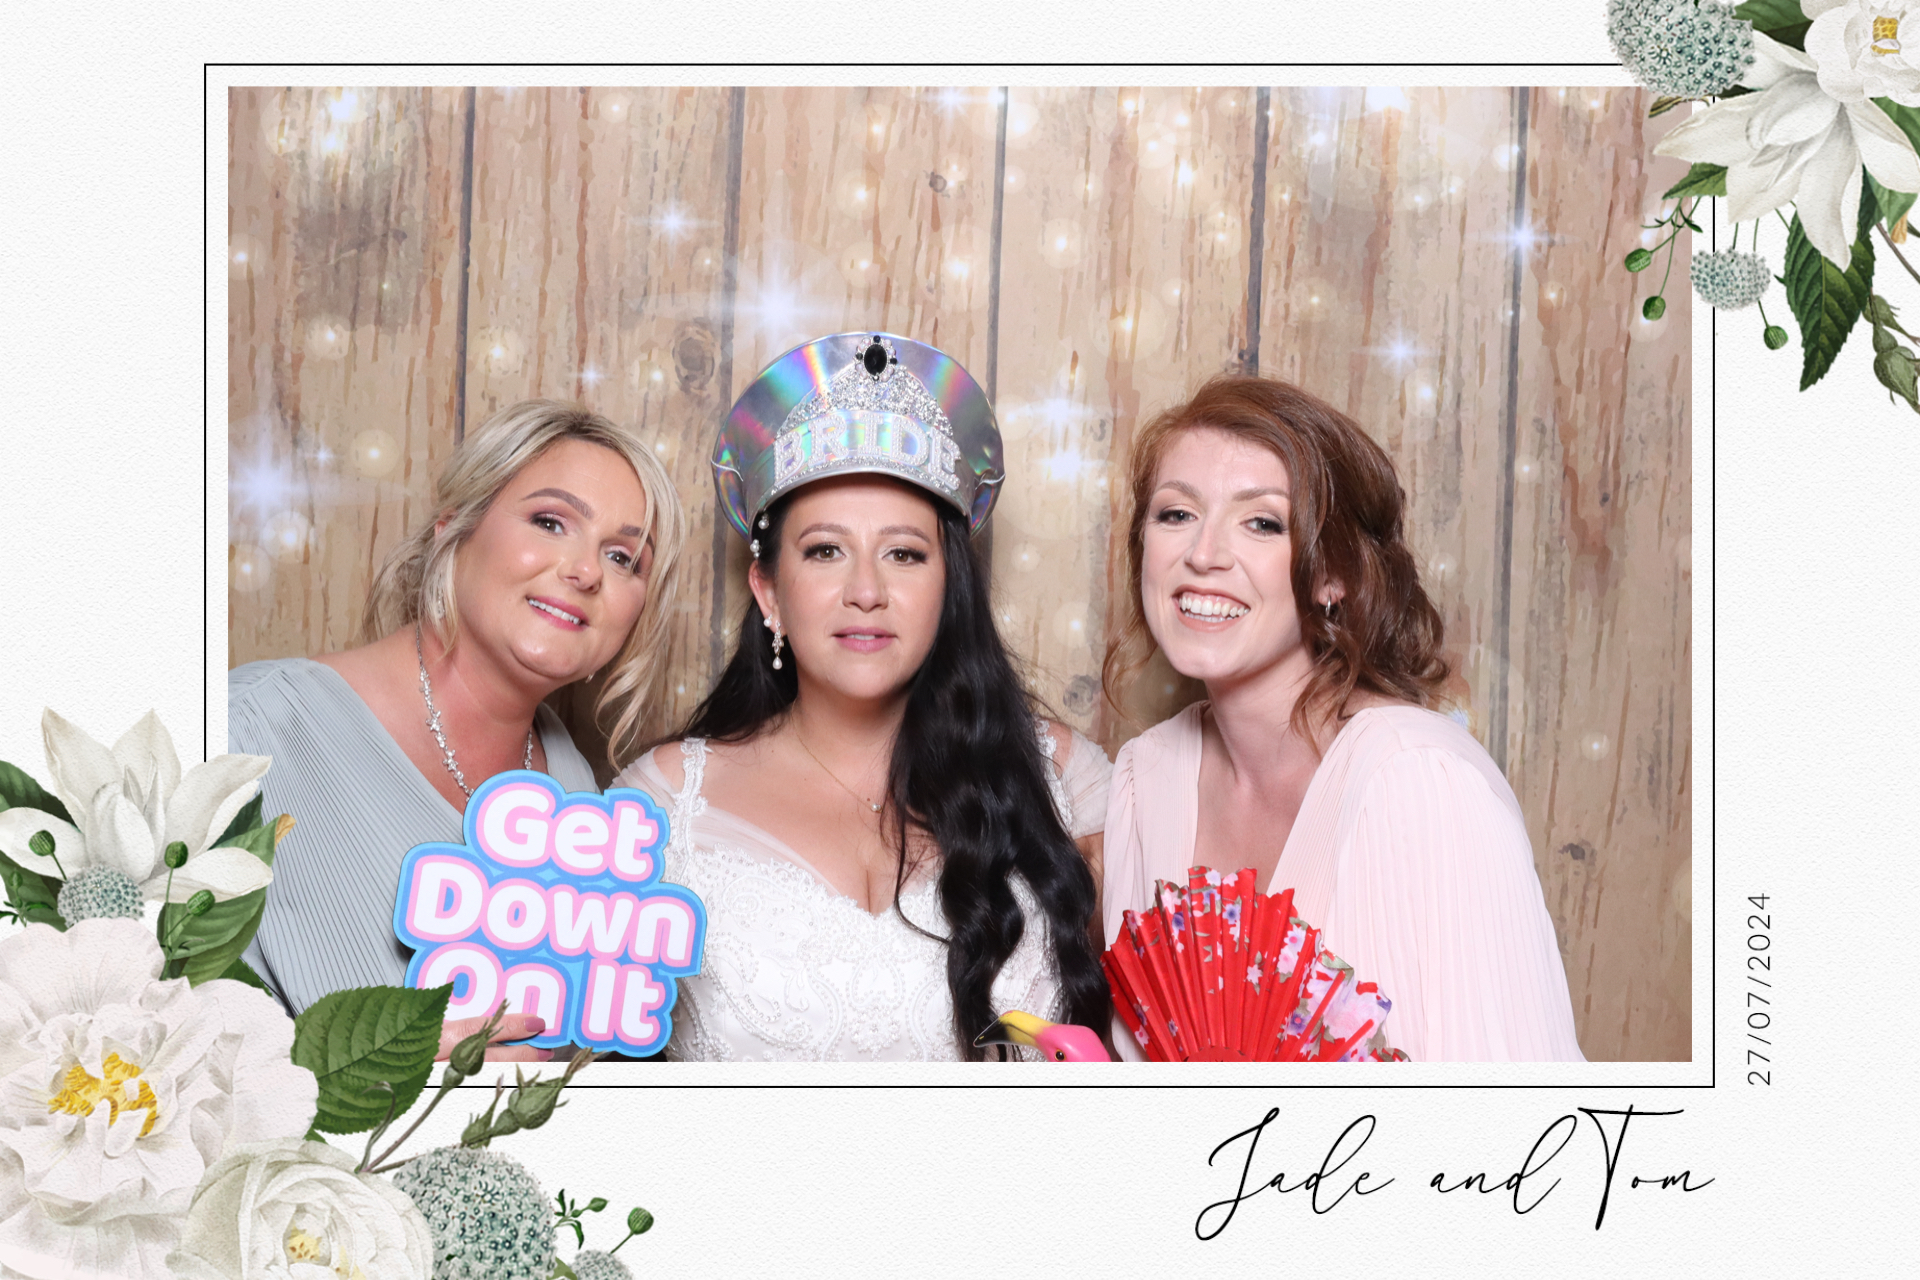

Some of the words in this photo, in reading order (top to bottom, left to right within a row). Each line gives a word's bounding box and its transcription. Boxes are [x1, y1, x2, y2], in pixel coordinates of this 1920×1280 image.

[773, 412, 962, 491] BRIDE
[481, 787, 655, 877] Get
[410, 859, 692, 963] Down
[421, 946, 562, 1031] On
[587, 962, 662, 1041] It
